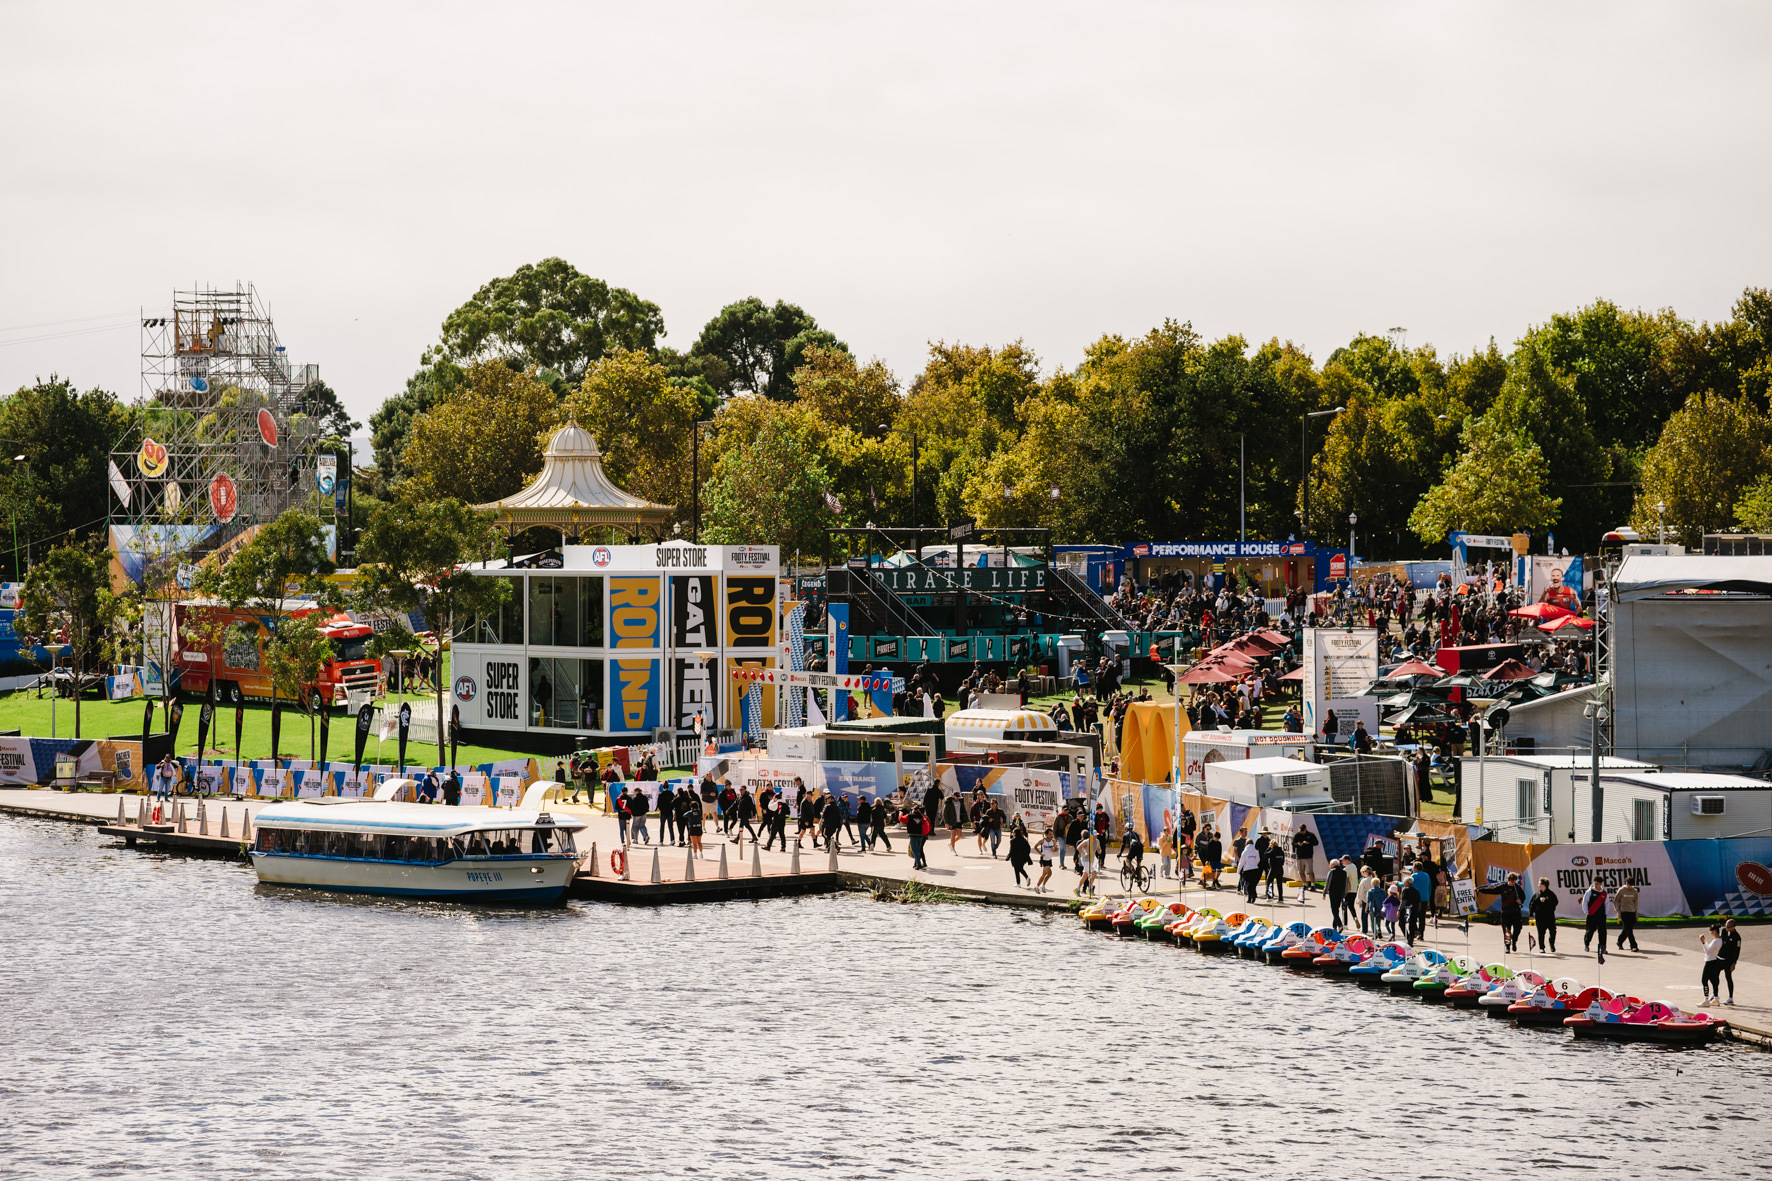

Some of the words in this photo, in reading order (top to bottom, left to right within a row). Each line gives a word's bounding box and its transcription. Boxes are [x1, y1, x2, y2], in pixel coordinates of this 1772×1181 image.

[1152, 543, 1236, 555] PERFORMANCE
[1240, 543, 1280, 555] HOUSE
[592, 549, 611, 566] AFL
[656, 548, 681, 567] SUPER
[682, 547, 707, 567] STORE
[731, 552, 747, 561] FOOTY
[748, 552, 771, 561] FESTIVAL
[801, 580, 822, 588] LEGEND
[875, 571, 972, 589] PIRATE
[992, 570, 1045, 588] LIFE
[906, 597, 927, 605] BAR
[611, 578, 661, 729] ROUND
[681, 577, 714, 728] GATHER
[486, 662, 519, 690] SUPER
[809, 674, 821, 685] FOOTY
[821, 675, 838, 686] FESTIVAL
[455, 680, 476, 697] AFL
[487, 692, 519, 720] STORE
[0, 753, 26, 766] ESTIVAL
[838, 775, 876, 783] ENTRANCE
[1014, 788, 1034, 803] FOOTY
[1035, 789, 1058, 806] FESTIVAL
[622, 799, 628, 809] 7
[1573, 857, 1588, 865] AFL
[1603, 856, 1632, 864] Macca's
[466, 871, 492, 885] POPEYE
[493, 871, 503, 881] III
[1557, 868, 1592, 888] FOOTY
[1457, 888, 1472, 897] FREE
[1456, 895, 1475, 904] ENTRY
[1233, 914, 1244, 922] 15
[1322, 929, 1333, 937] 10
[1426, 952, 1432, 960] 9
[1460, 959, 1465, 967] 5
[1493, 967, 1498, 975] 1
[1561, 982, 1568, 990] 6
[1591, 990, 1598, 998] 4
[1648, 1003, 1661, 1013] 13
